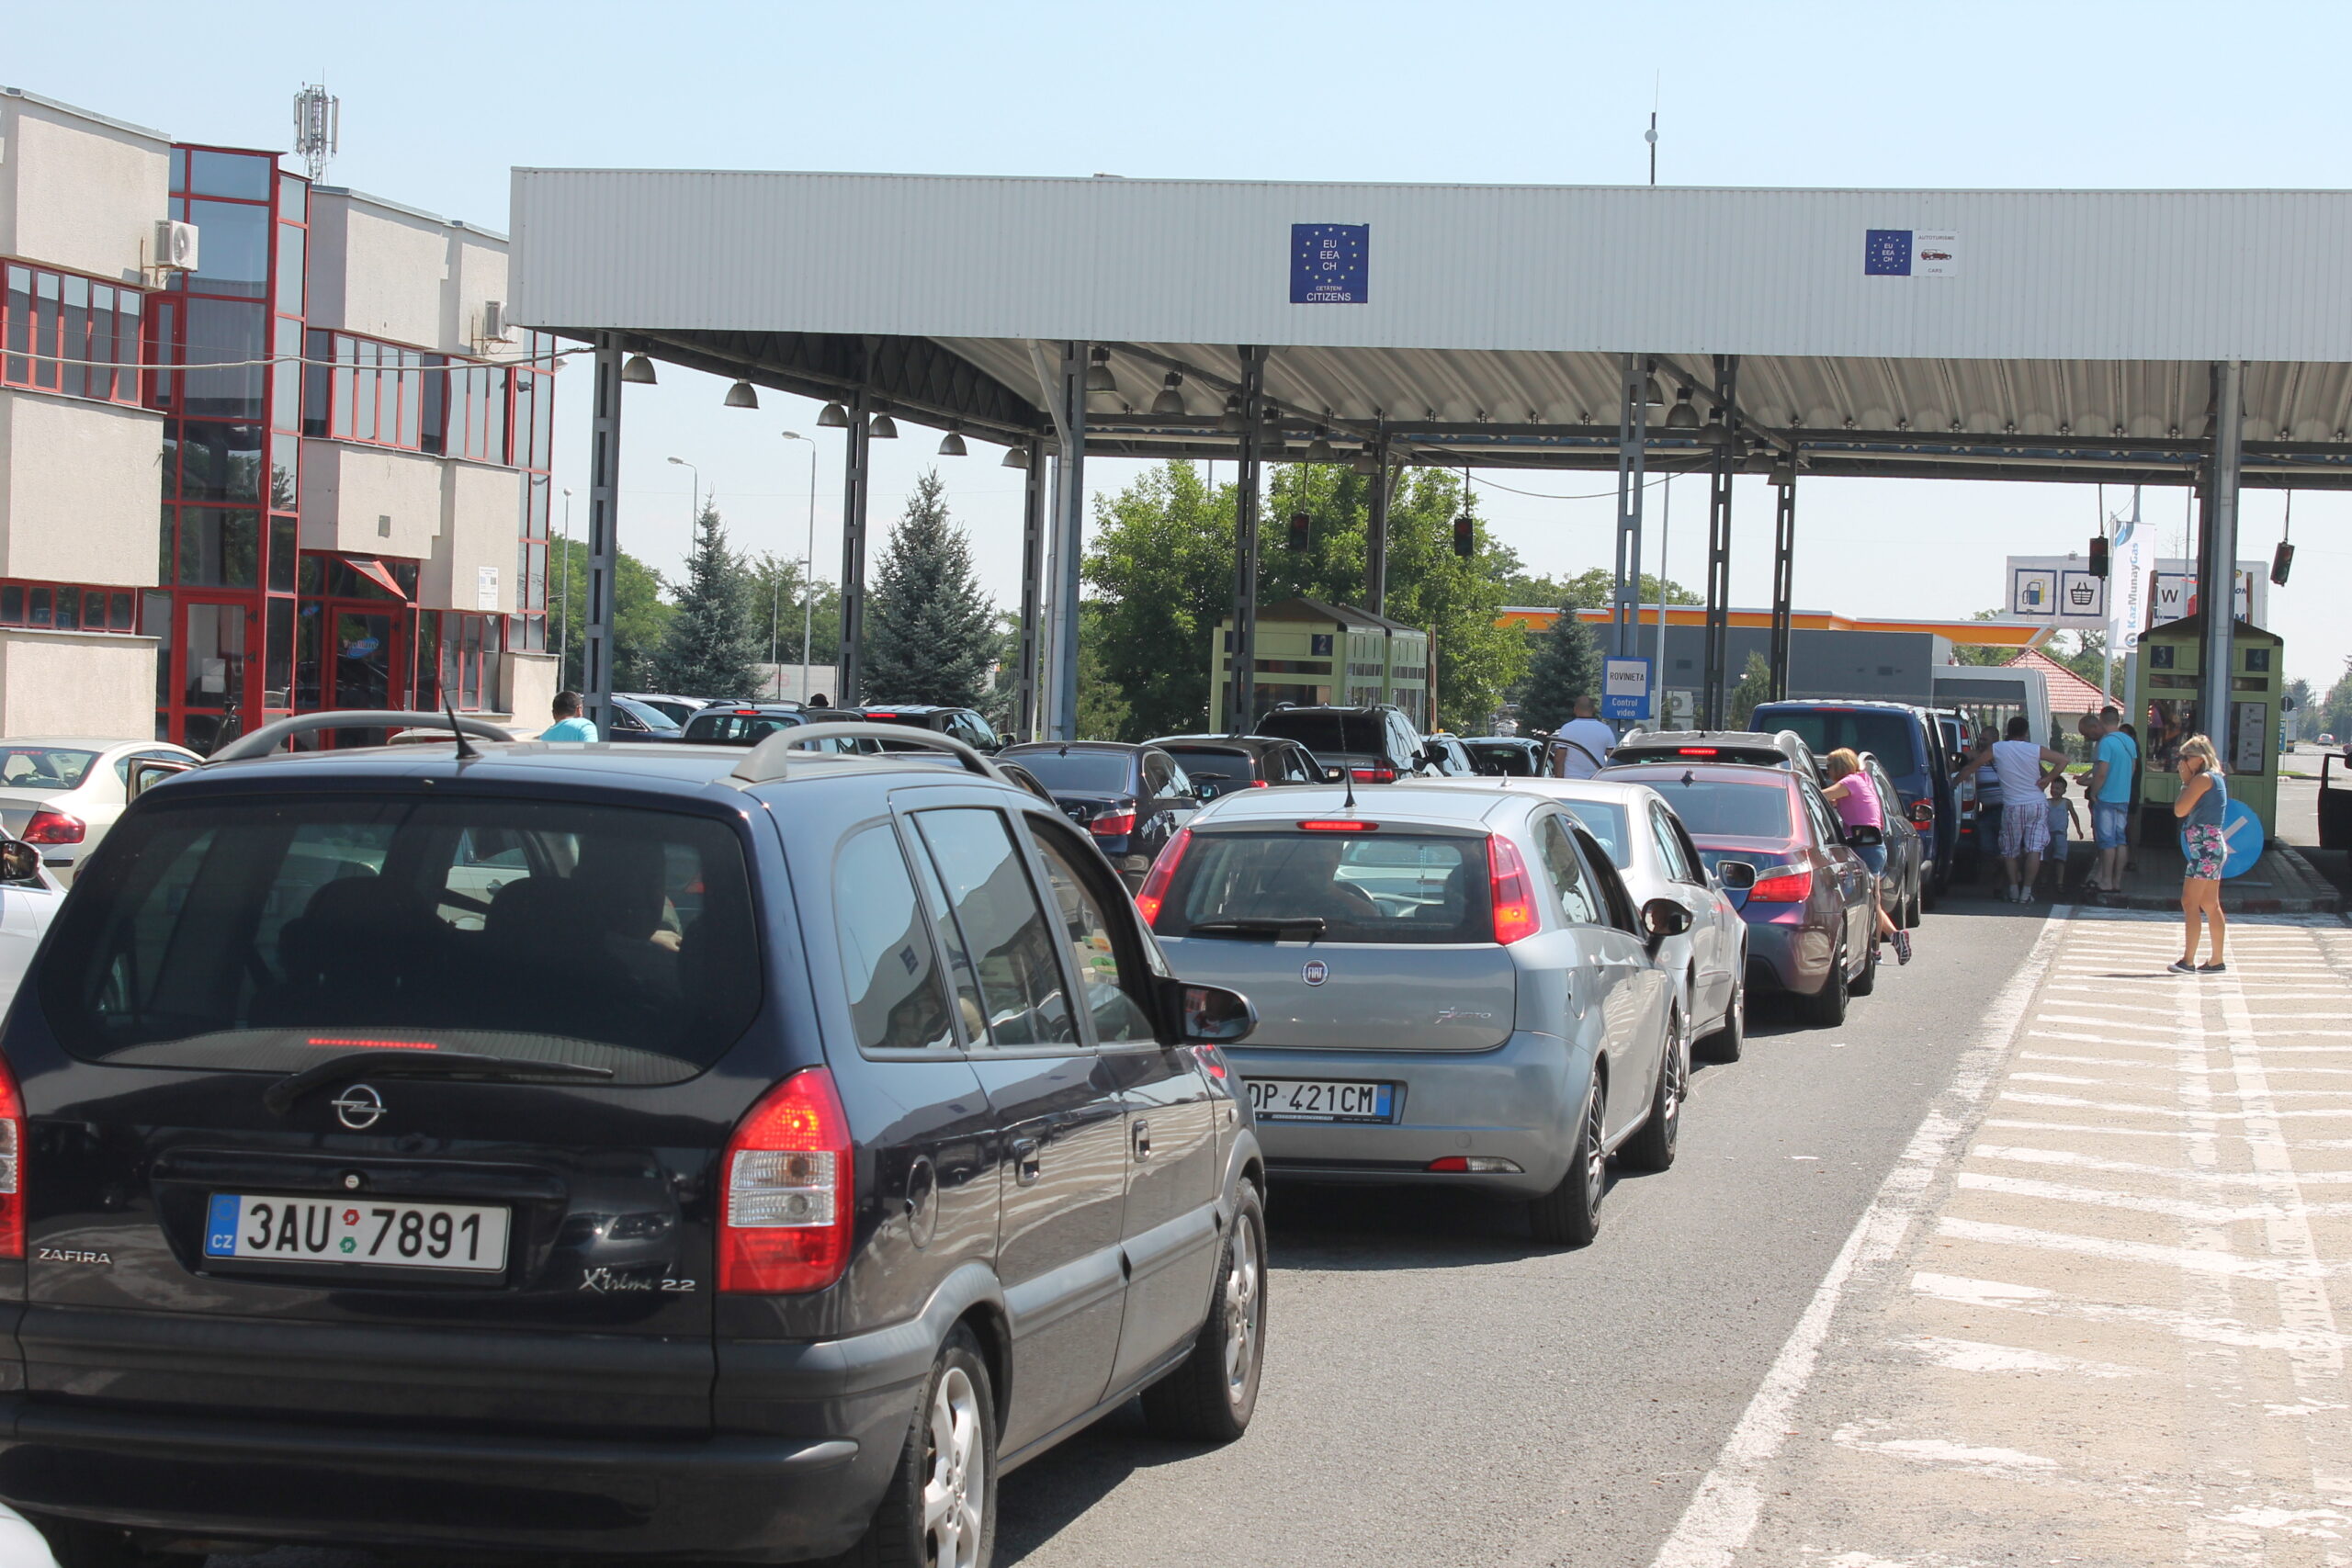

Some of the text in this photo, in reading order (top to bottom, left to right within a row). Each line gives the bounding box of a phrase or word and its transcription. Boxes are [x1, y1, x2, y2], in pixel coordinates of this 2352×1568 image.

[1323, 240, 1337, 248] EU
[1319, 251, 1340, 259] EEA
[1322, 262, 1337, 270] CH
[1306, 292, 1351, 301] CITIZENS
[2127, 543, 2140, 628] KazMunayGas
[1318, 635, 1327, 651] 2
[2158, 646, 2166, 662] 3
[1610, 671, 1645, 681] ROVINIETA
[1611, 697, 1637, 706] Control
[1617, 708, 1635, 716] video
[1307, 966, 1323, 979] FIAT
[1247, 1083, 1374, 1113] DP 421CM
[247, 1202, 481, 1261] 3AU 7891
[212, 1235, 233, 1248] CZ
[39, 1247, 112, 1265] ZAFIRA
